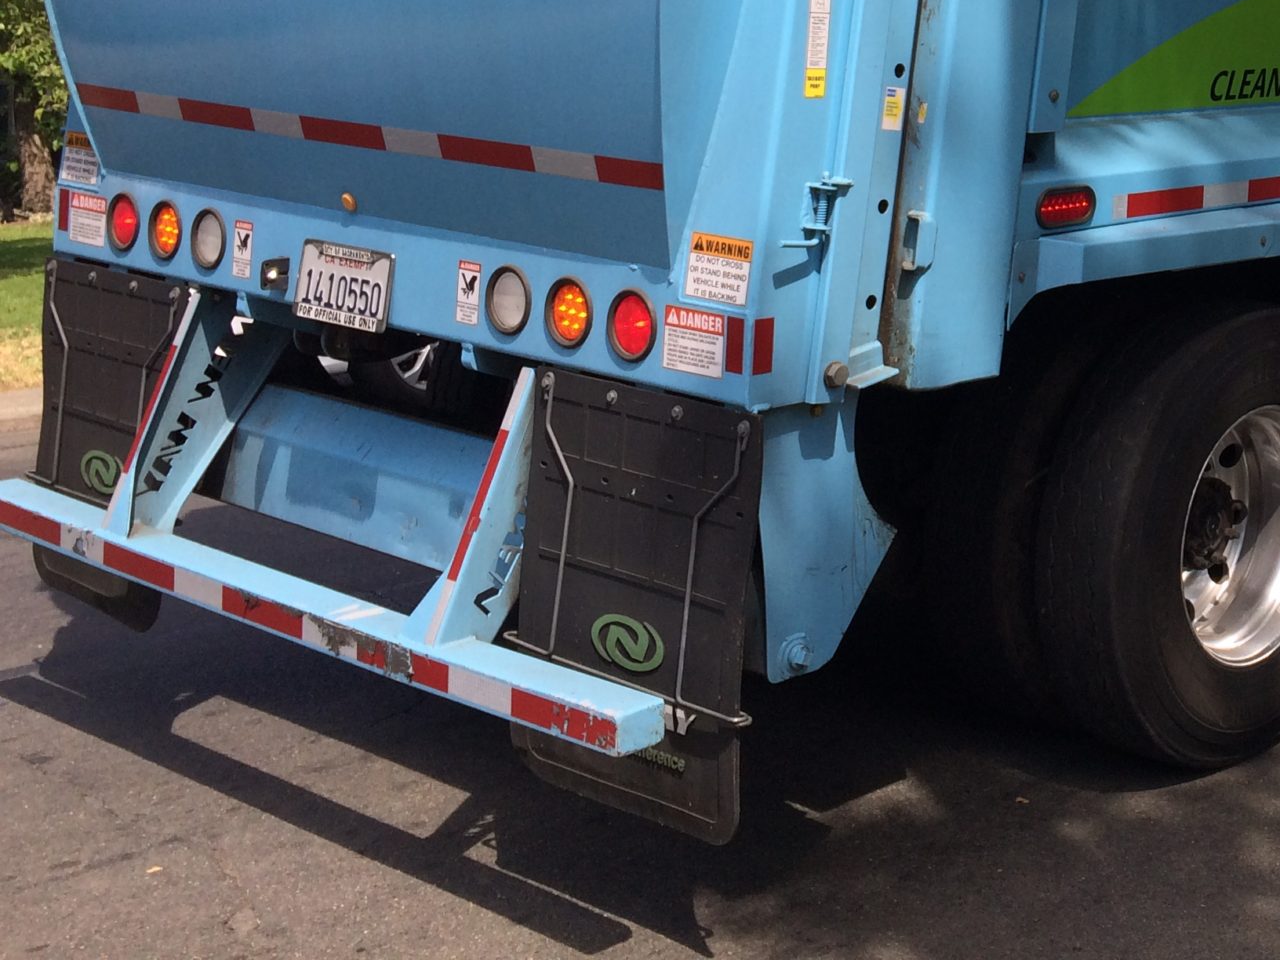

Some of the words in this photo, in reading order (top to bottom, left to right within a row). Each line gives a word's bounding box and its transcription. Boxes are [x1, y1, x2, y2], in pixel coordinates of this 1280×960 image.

[705, 239, 751, 259] WARNING
[339, 256, 369, 270] EXEMPT
[695, 254, 705, 264] DO
[707, 256, 720, 266] NOT
[720, 259, 744, 271] CROSS
[690, 264, 699, 273] OR
[700, 266, 721, 278] STAND
[722, 270, 747, 283] BEHIND
[301, 268, 382, 319] 1410550
[693, 275, 720, 289] VEHICLE
[720, 282, 742, 293] WHILE
[693, 287, 700, 295] IT
[700, 289, 707, 298] IS
[708, 290, 737, 303] BACKING
[298, 304, 312, 316] FOR
[313, 308, 342, 323] OFFICIAL
[343, 314, 356, 326] USE
[359, 315, 377, 331] ONLY
[680, 309, 722, 334] DANGER
